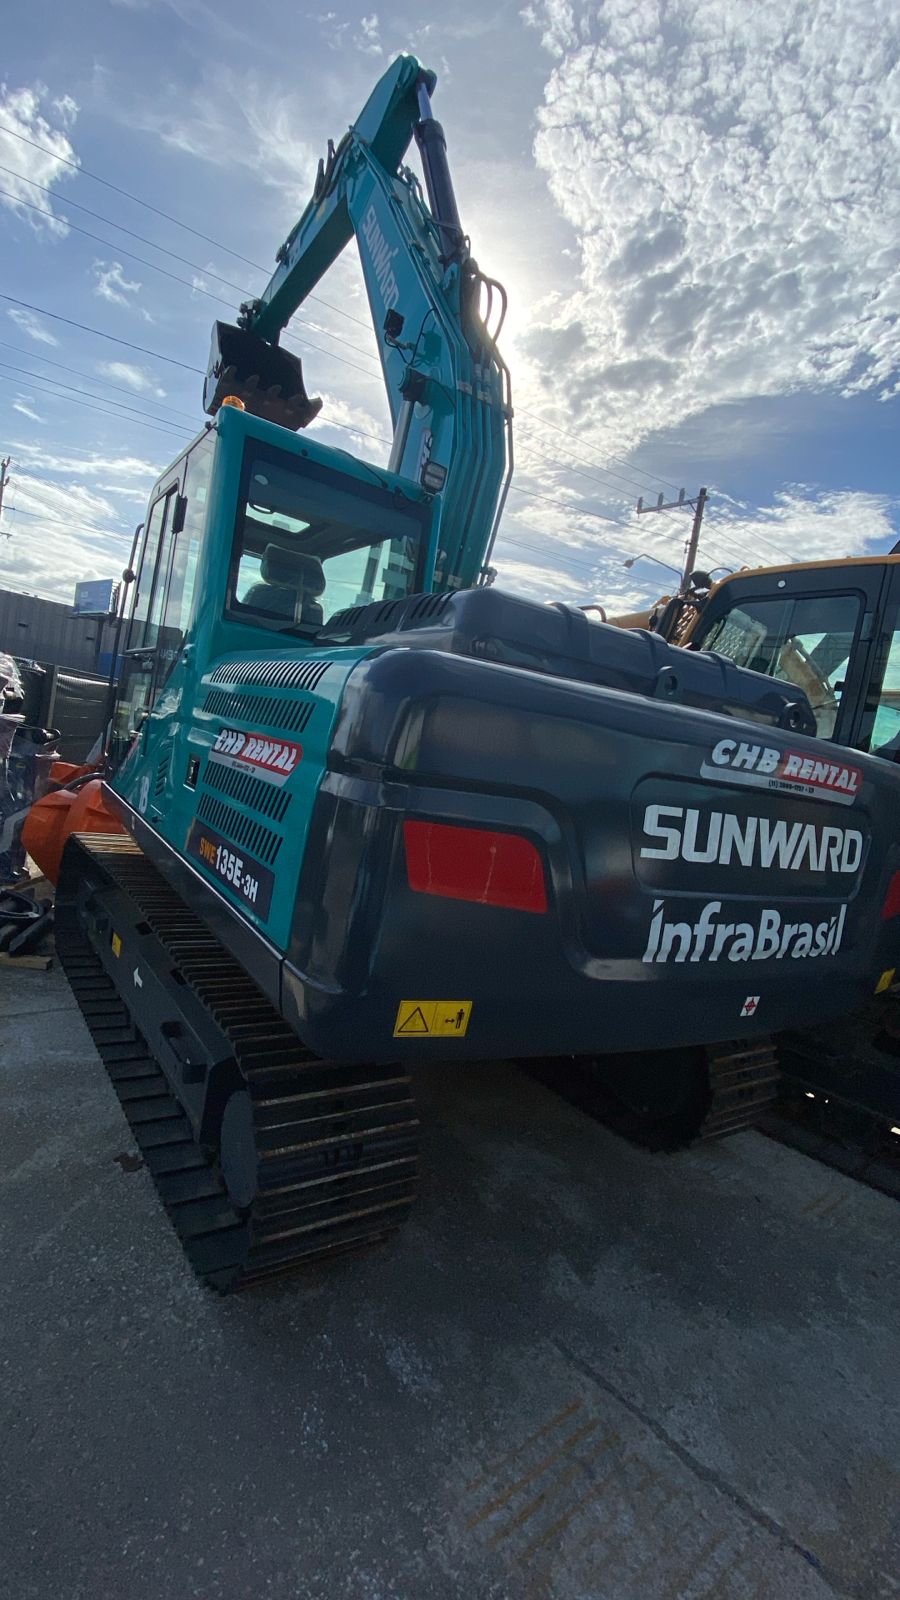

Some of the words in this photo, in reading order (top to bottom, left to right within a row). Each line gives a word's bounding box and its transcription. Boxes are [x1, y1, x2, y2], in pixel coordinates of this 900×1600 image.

[362, 204, 399, 310] SUNWARD
[214, 729, 246, 755] CHB
[241, 738, 297, 772] RENTAL
[711, 739, 781, 773] CHB
[783, 753, 858, 791] RENTAL
[640, 804, 863, 873] SUNWARD
